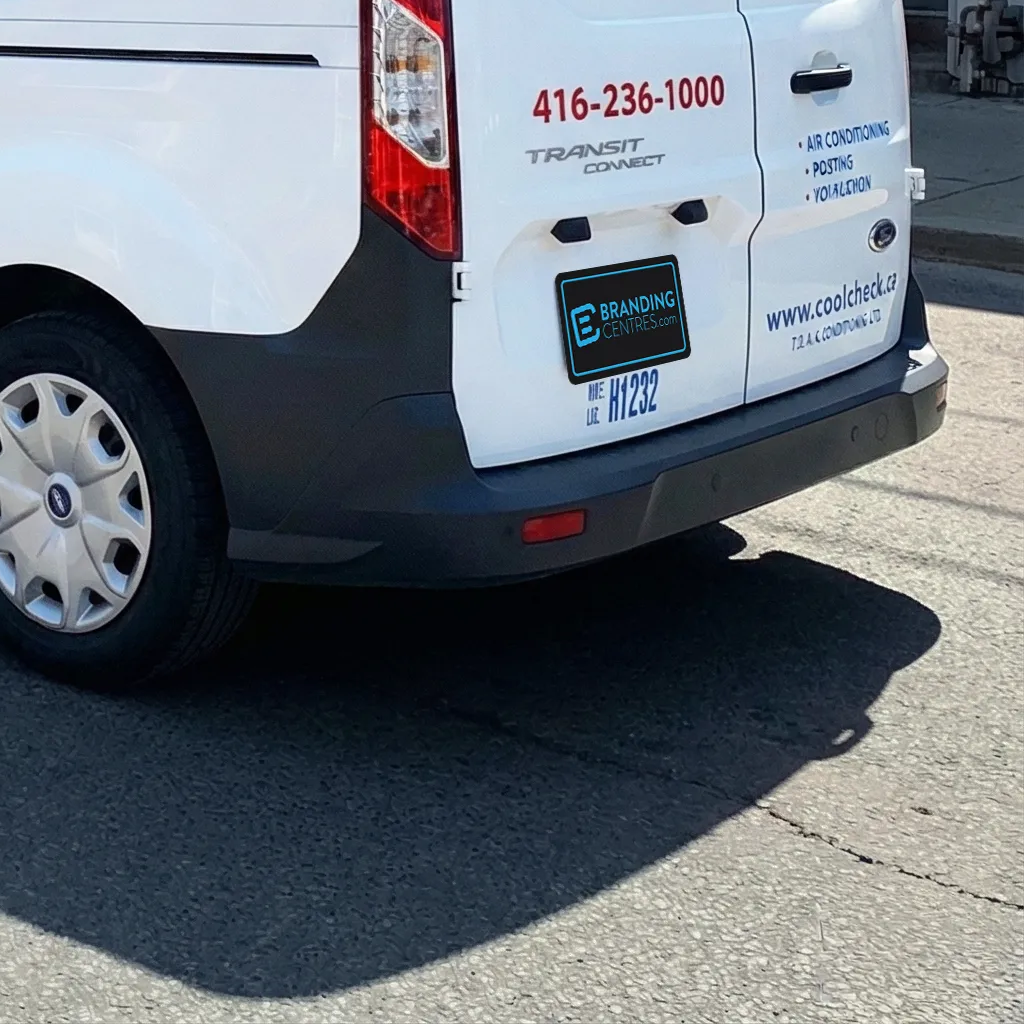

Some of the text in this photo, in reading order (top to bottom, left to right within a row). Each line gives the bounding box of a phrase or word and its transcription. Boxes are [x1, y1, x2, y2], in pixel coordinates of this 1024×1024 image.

[532, 74, 725, 123] 416-236-1000
[525, 137, 666, 174] TRANSIT CONNECT
[807, 134, 824, 152] AIR
[766, 272, 897, 331] www.coolcheck.ca
[608, 368, 659, 423] H1232
